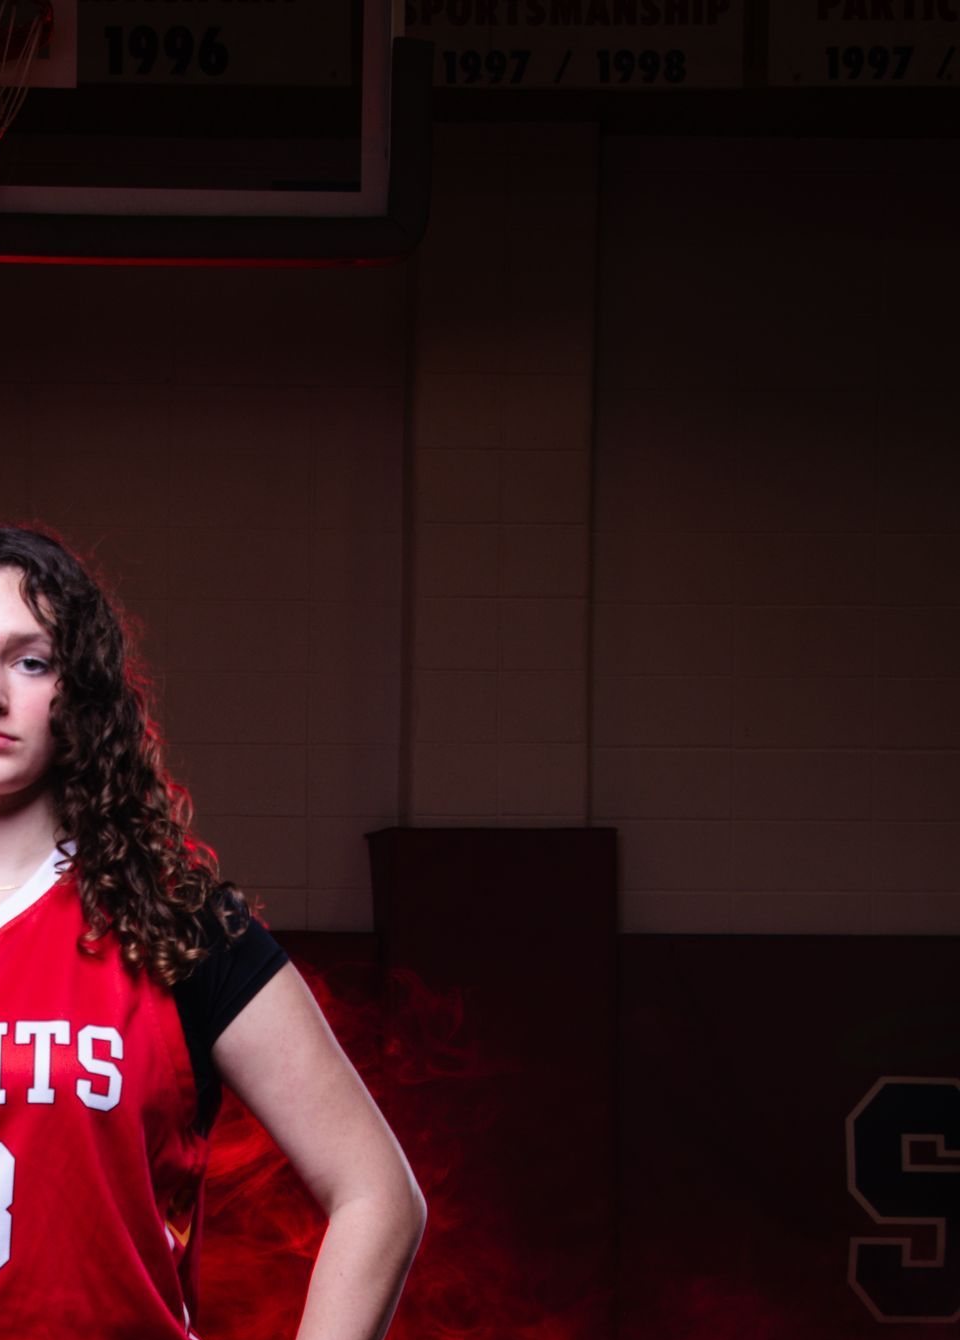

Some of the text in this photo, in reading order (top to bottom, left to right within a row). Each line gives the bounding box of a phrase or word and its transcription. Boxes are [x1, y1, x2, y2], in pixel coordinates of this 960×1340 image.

[104, 25, 229, 76] 1996
[443, 50, 687, 84] 1997 / 1998
[826, 45, 915, 80] 1997
[845, 1075, 960, 1324] S
